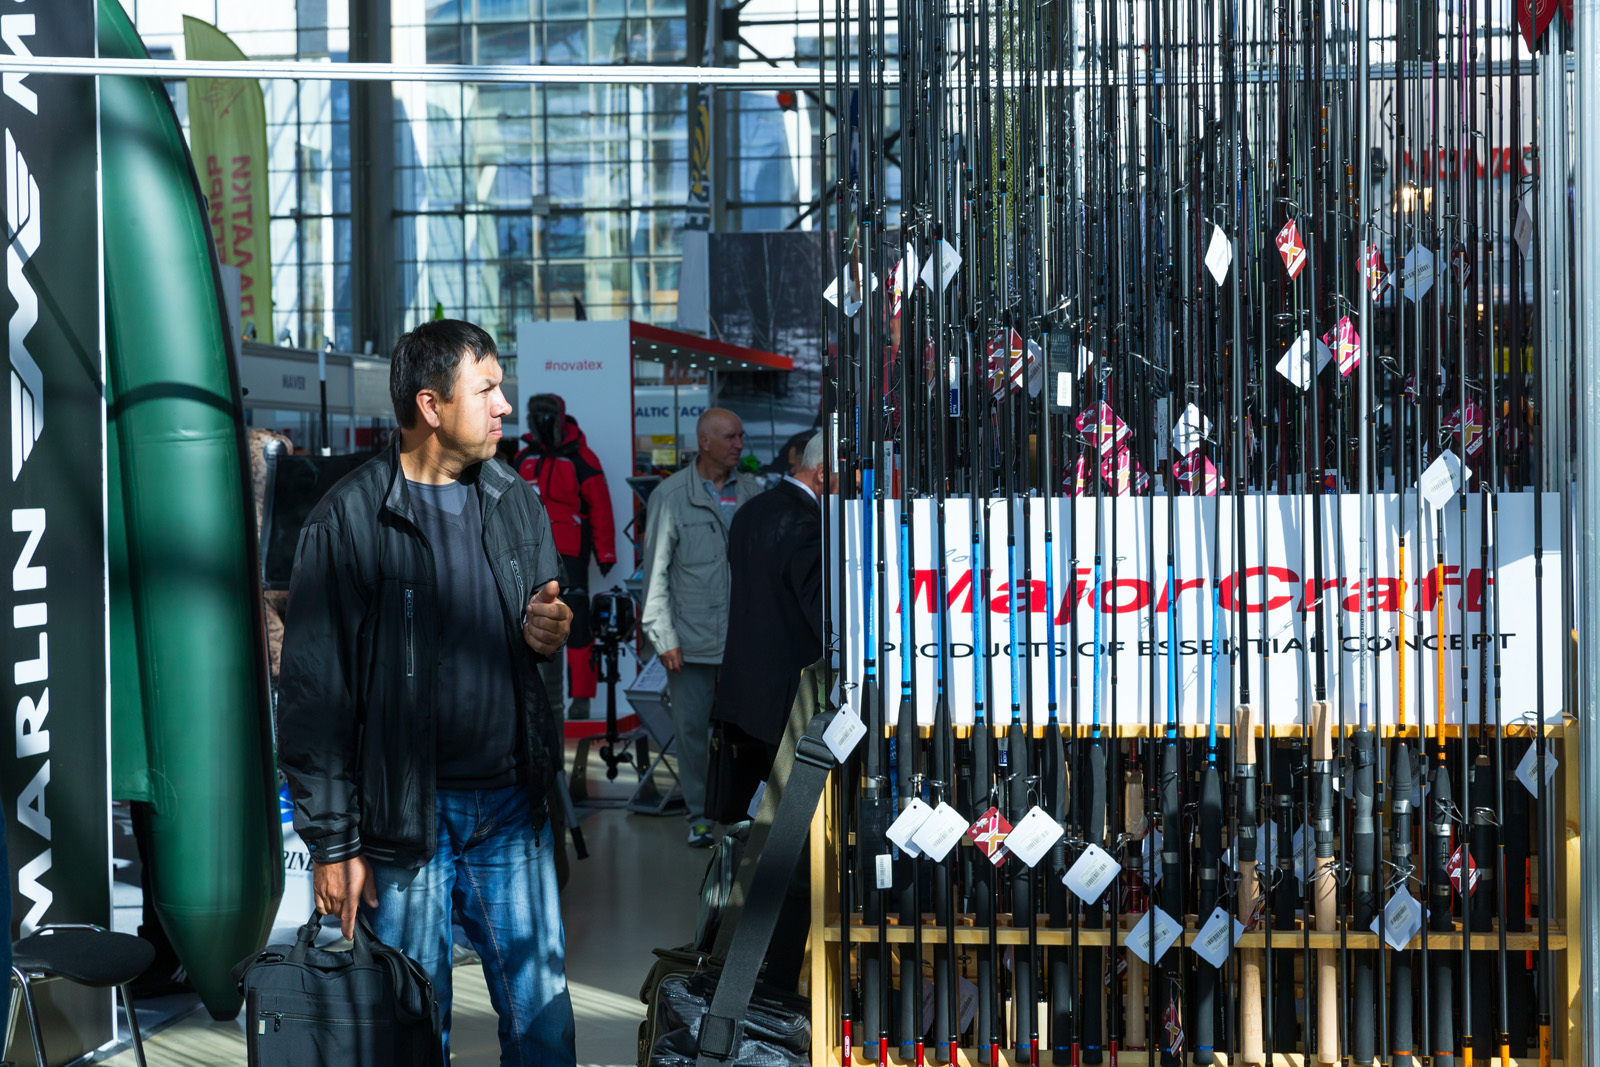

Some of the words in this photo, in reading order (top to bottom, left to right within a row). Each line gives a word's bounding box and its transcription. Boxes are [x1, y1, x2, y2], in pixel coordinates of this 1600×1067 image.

[545, 360, 604, 371] #novatex
[635, 406, 669, 417] ALTIC
[676, 405, 707, 417] ACK
[896, 567, 1206, 626] Major
[1217, 564, 1494, 614] Craft
[1077, 641, 1125, 657] OF
[1138, 637, 1329, 656] ESSENTIAL
[1342, 633, 1516, 651] CONCEPT
[11, 507, 53, 940] MARLIN
